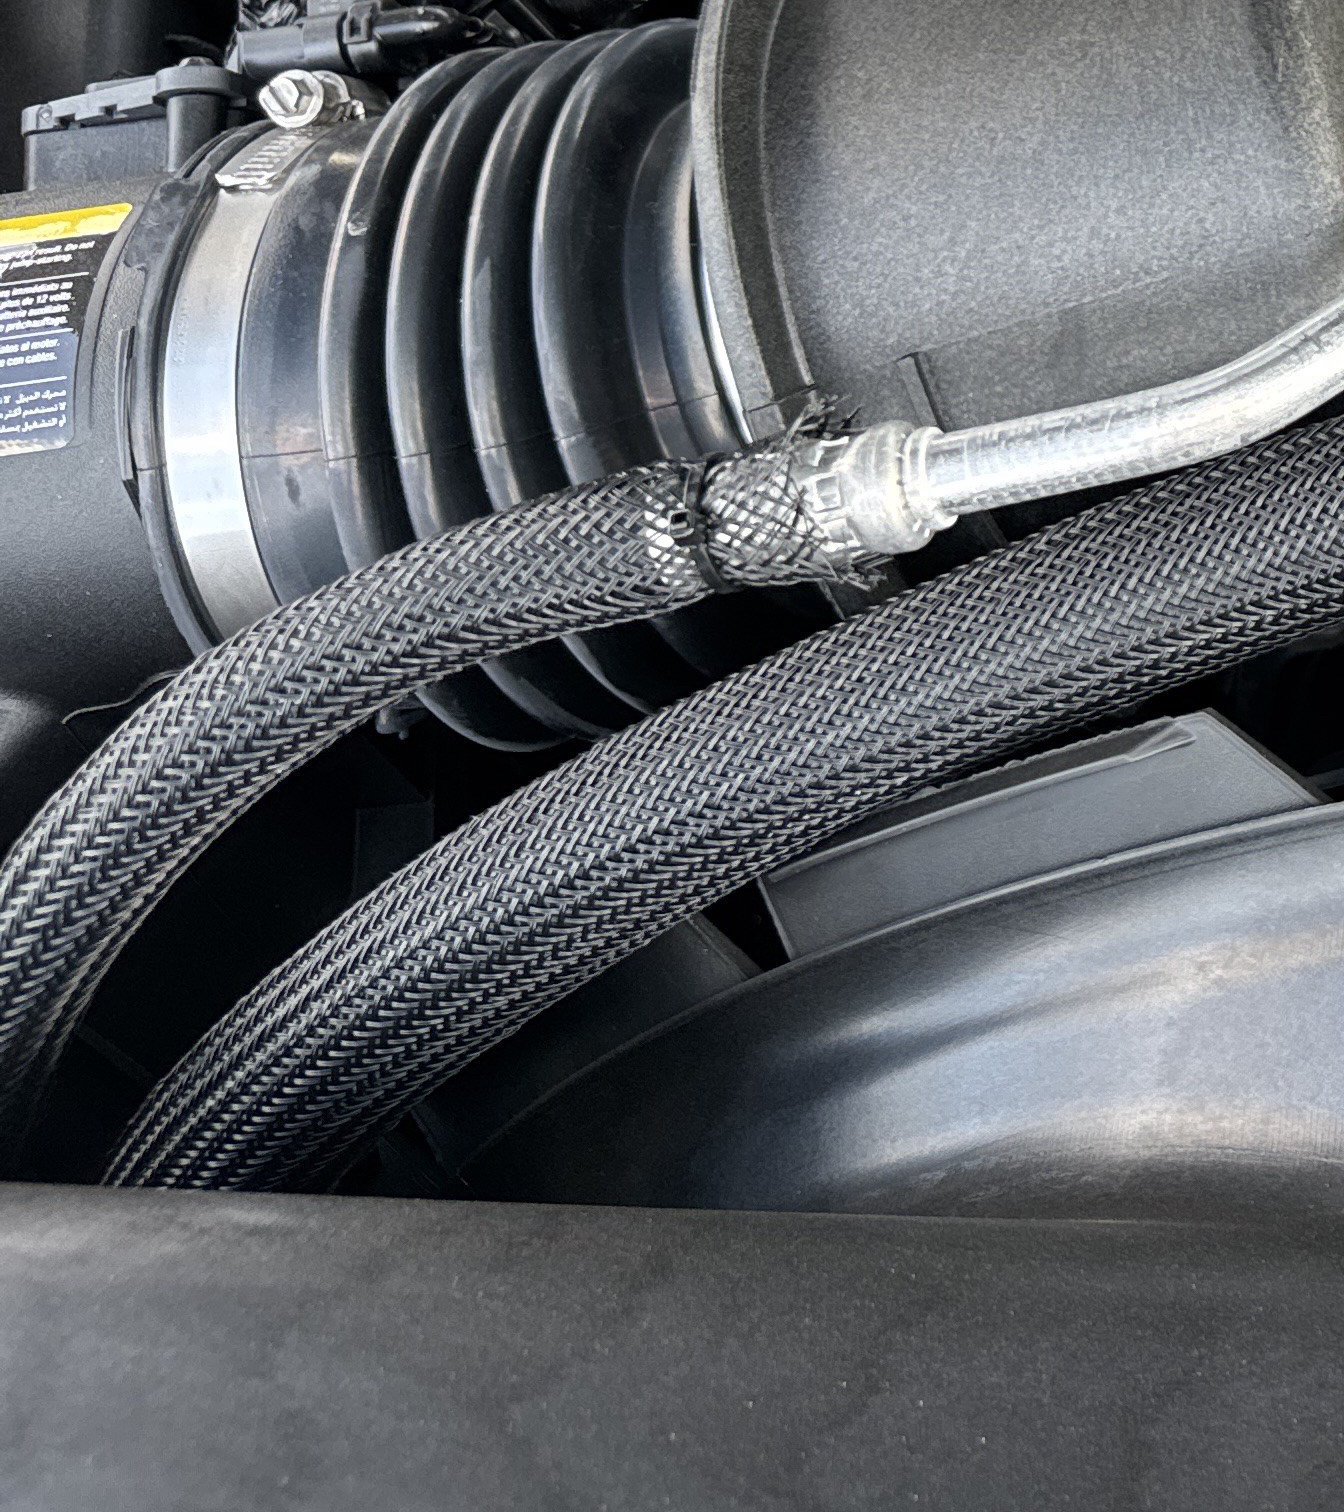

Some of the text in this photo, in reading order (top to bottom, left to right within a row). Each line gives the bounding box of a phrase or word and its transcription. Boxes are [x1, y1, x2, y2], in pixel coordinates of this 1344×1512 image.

[21, 297, 35, 306] de
[36, 294, 48, 304] 12
[31, 339, 61, 350] motor.
[25, 352, 58, 364] cables.
